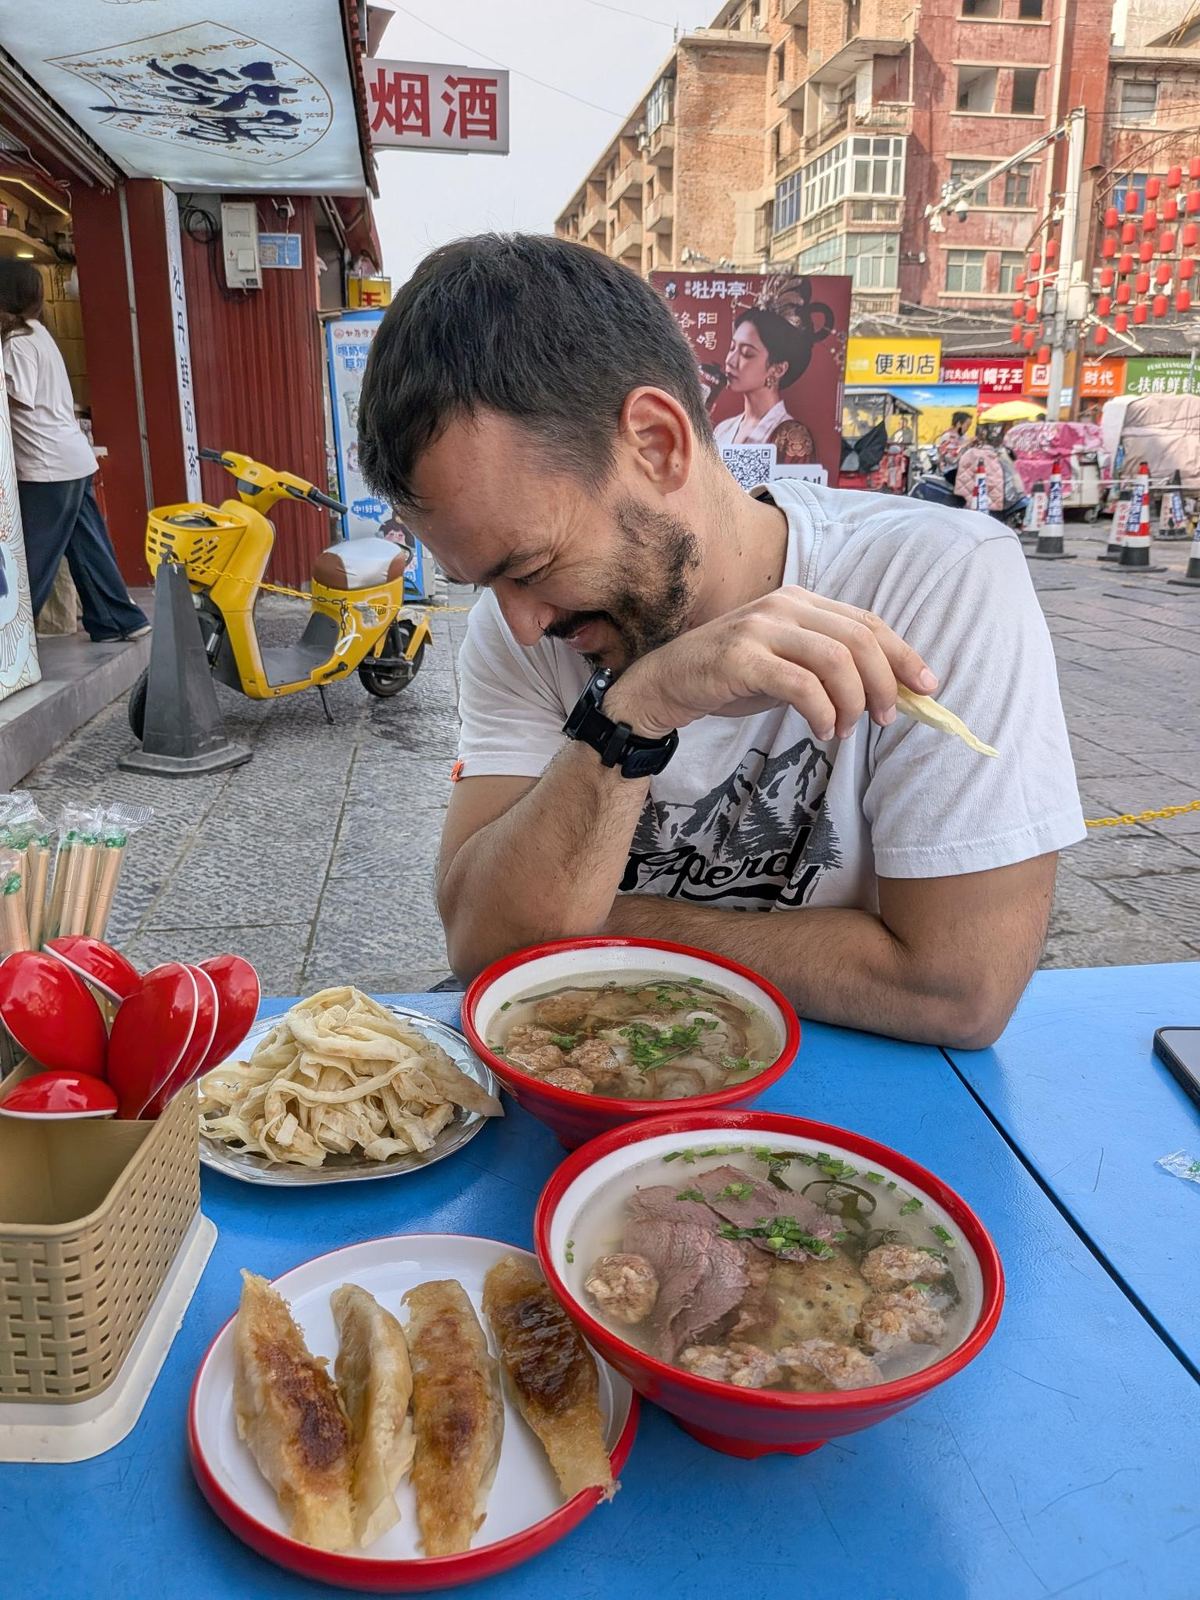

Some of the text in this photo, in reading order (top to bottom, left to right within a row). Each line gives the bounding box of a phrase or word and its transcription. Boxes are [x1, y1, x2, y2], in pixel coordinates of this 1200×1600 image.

[370, 68, 498, 141] 烟酒
[691, 280, 746, 300] 牡丹亭
[875, 353, 936, 375] 便利店
[1084, 371, 1114, 386] 时代
